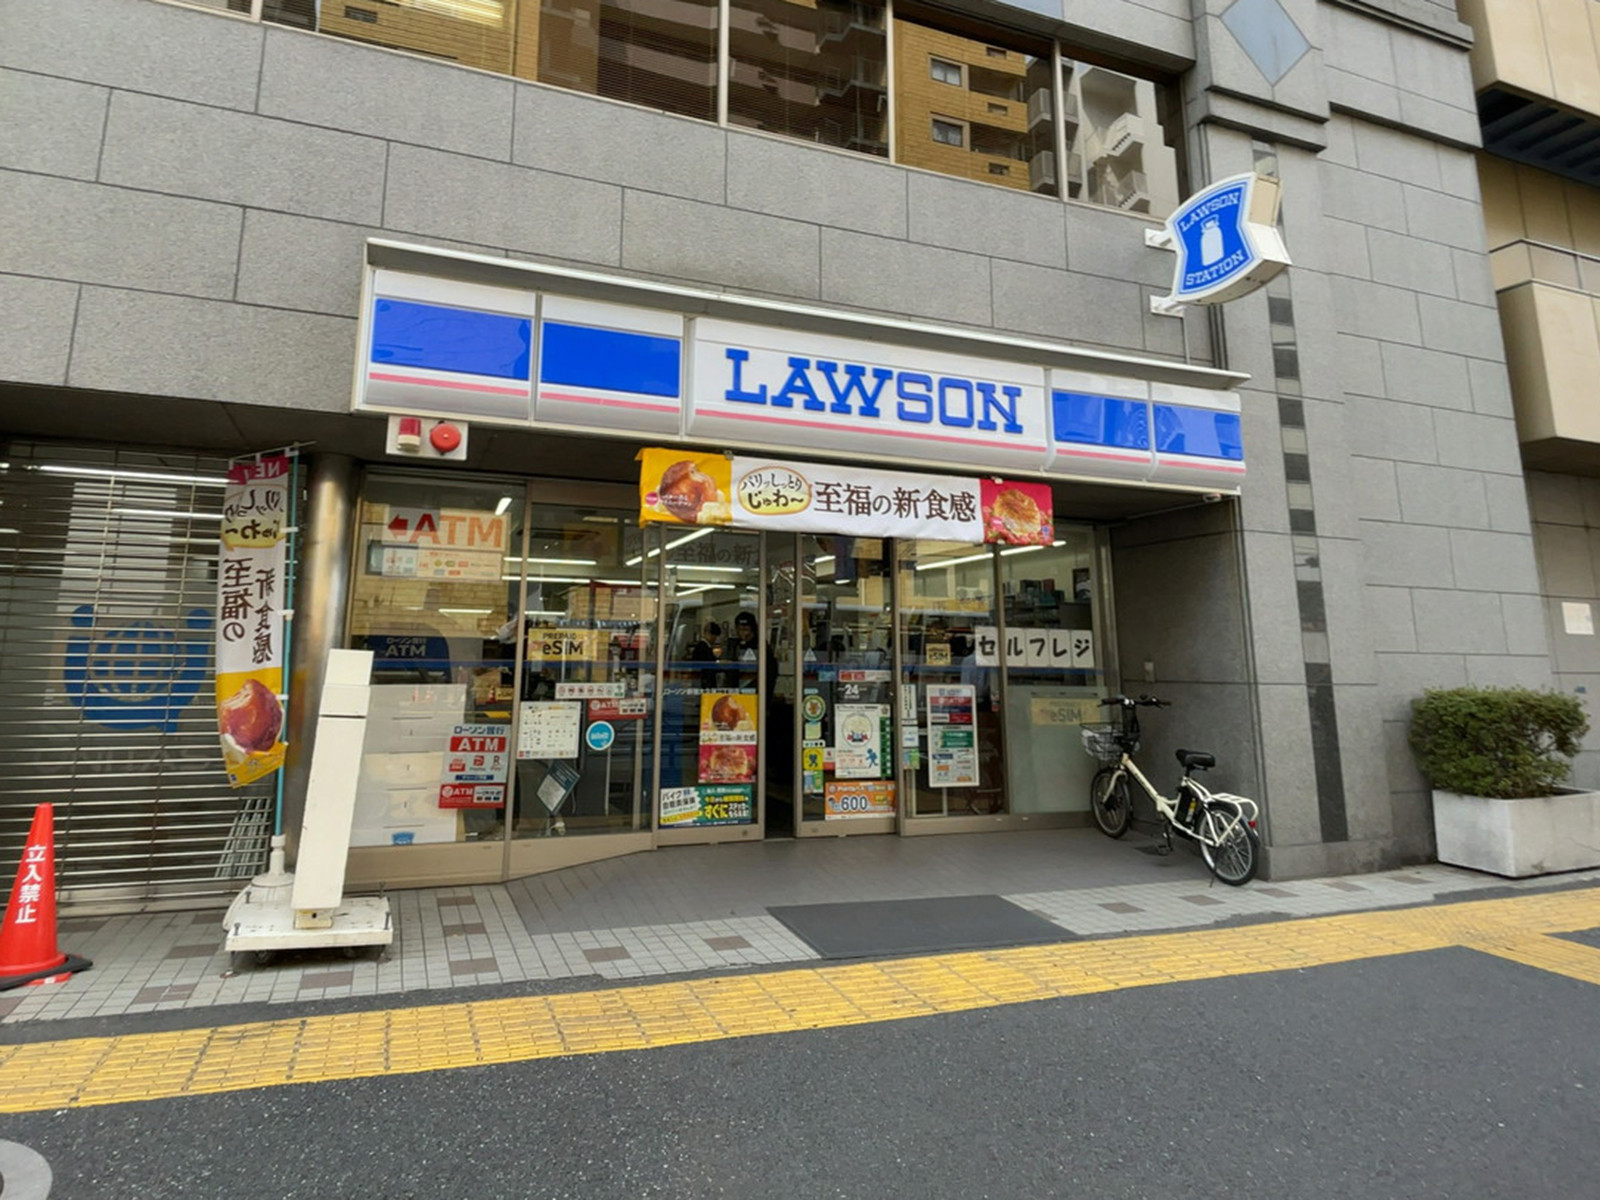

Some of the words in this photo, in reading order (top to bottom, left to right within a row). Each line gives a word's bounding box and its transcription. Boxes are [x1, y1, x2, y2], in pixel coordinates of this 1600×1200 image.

[1180, 192, 1240, 231] LAWSON
[1185, 249, 1244, 286] STATION
[725, 348, 1023, 434] LAWSON
[813, 481, 977, 522] 至福の新食感
[409, 513, 503, 548] ATM
[385, 645, 426, 657] ATM
[542, 641, 584, 655] eSIM
[978, 636, 1090, 657] セルフレジ
[844, 684, 859, 695] 24
[458, 738, 499, 751] ATM
[840, 795, 868, 811] 600
[15, 845, 46, 924] 立入禁止
